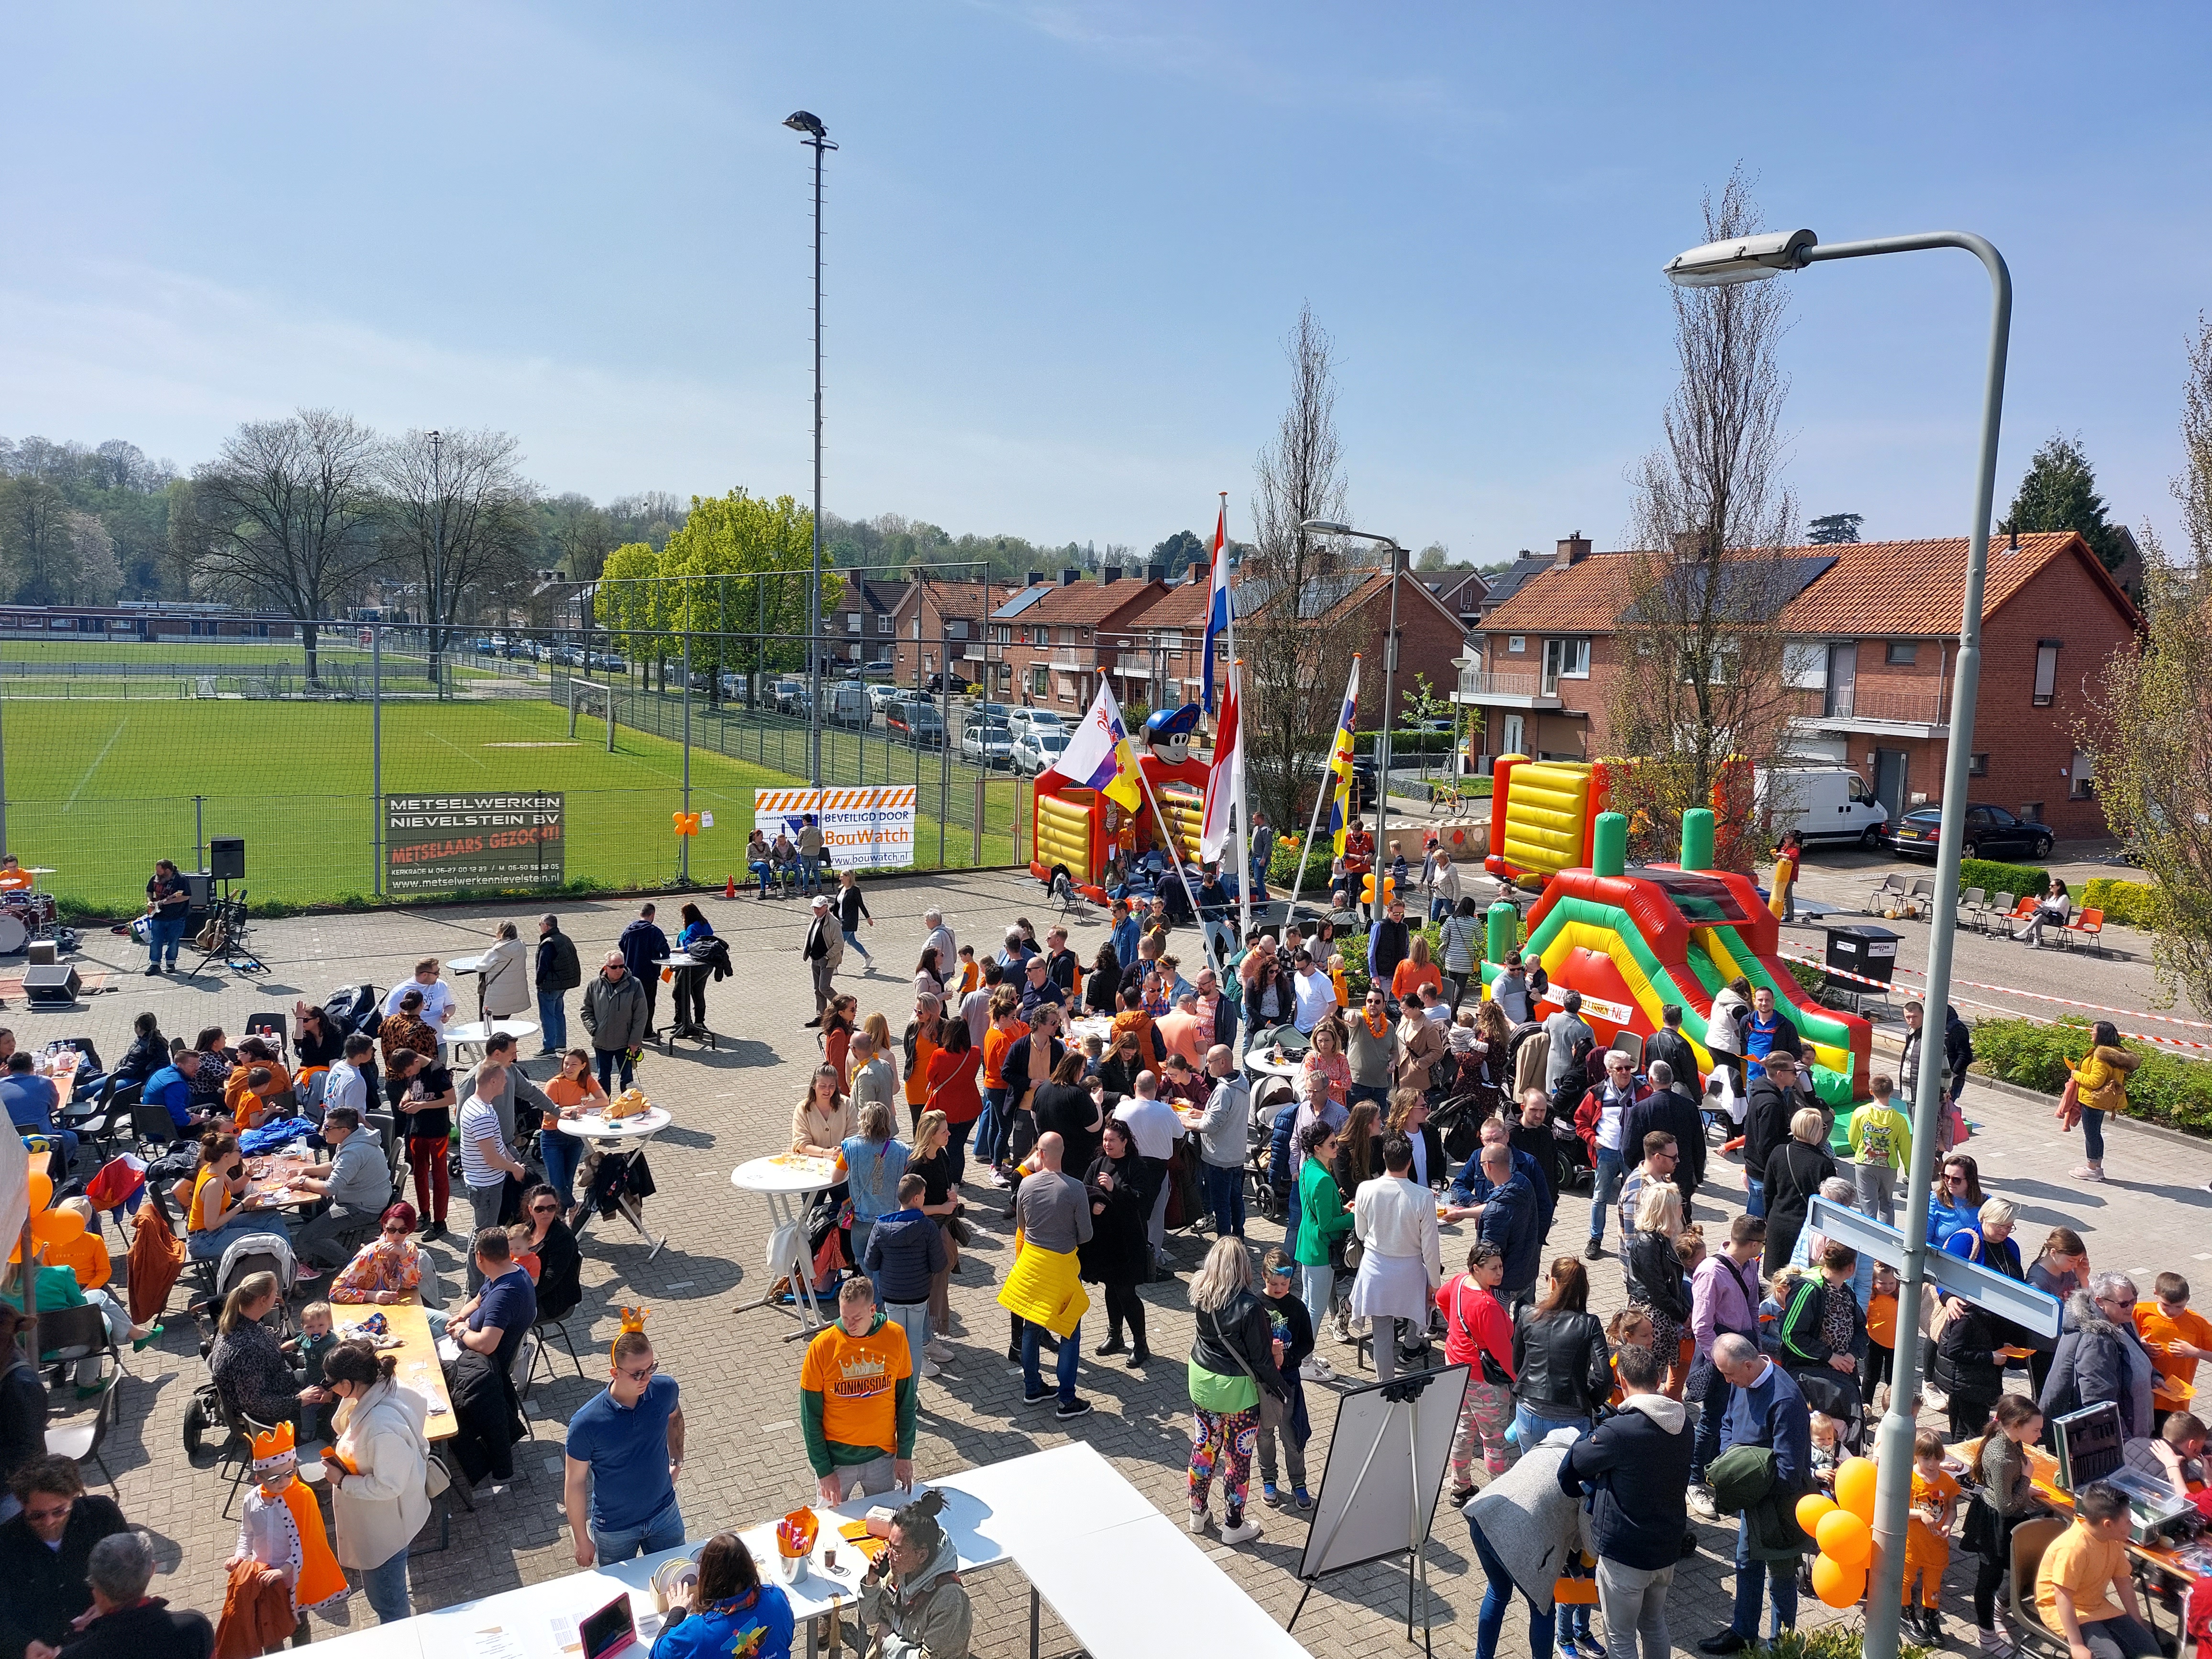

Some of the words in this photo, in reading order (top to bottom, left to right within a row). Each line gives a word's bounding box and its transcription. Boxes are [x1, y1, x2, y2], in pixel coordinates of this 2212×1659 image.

[390, 798, 560, 810] METSELWERKEN
[390, 815, 524, 828] NIEVELSTEIN
[533, 814, 559, 824] BV
[825, 812, 876, 822] BEVEILIGD
[879, 811, 909, 820] DOOR
[825, 827, 909, 845] BouWatch
[392, 836, 483, 864] METSELAARS
[489, 826, 560, 849] GEZOCHT!
[392, 873, 559, 888] www.metselwerkennievelstein.nl
[834, 1374, 892, 1395] KONINGSDAG
